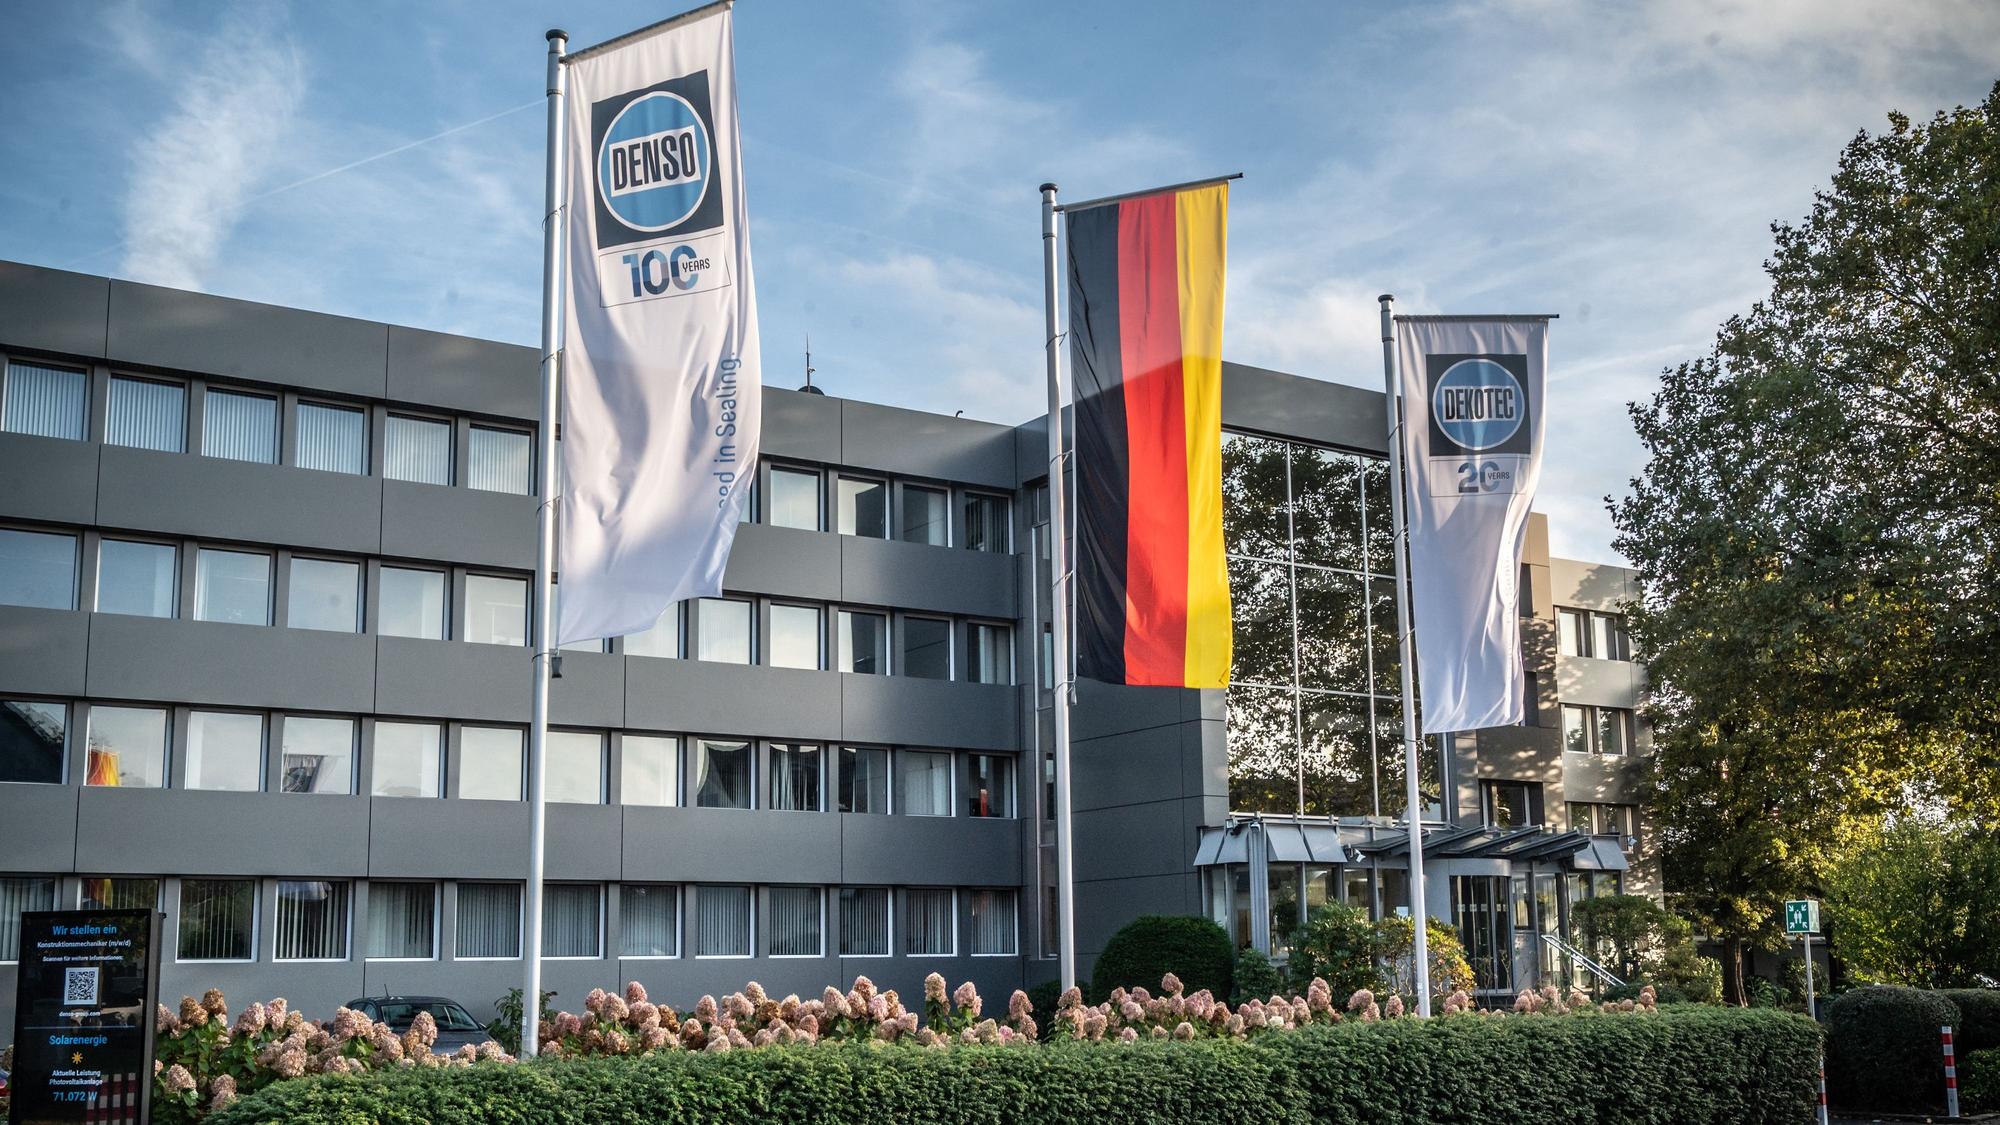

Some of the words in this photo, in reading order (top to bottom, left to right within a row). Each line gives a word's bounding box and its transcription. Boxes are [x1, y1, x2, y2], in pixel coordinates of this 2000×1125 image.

[612, 131, 696, 191] DENSO
[622, 245, 699, 298] 100
[681, 258, 711, 273] YEARS
[715, 352, 742, 437] Sealing.
[1444, 388, 1514, 420] DEKOTEC
[713, 444, 736, 463] in
[1457, 461, 1500, 494] 20
[1487, 471, 1510, 480] YEARS
[52, 925, 68, 936] Wir
[70, 924, 101, 935] stellen
[103, 924, 116, 934] ein
[37, 940, 108, 948] Konstruktionsmechaniker
[108, 939, 131, 948] (m/w/d)
[49, 1034, 108, 1046] Solarenergie
[52, 1069, 76, 1077] Aktuelle
[76, 1069, 101, 1078] Leistung
[49, 1077, 103, 1086] Photovoltaikanlage
[53, 1091, 86, 1102] 71.072
[87, 1091, 98, 1102] W
